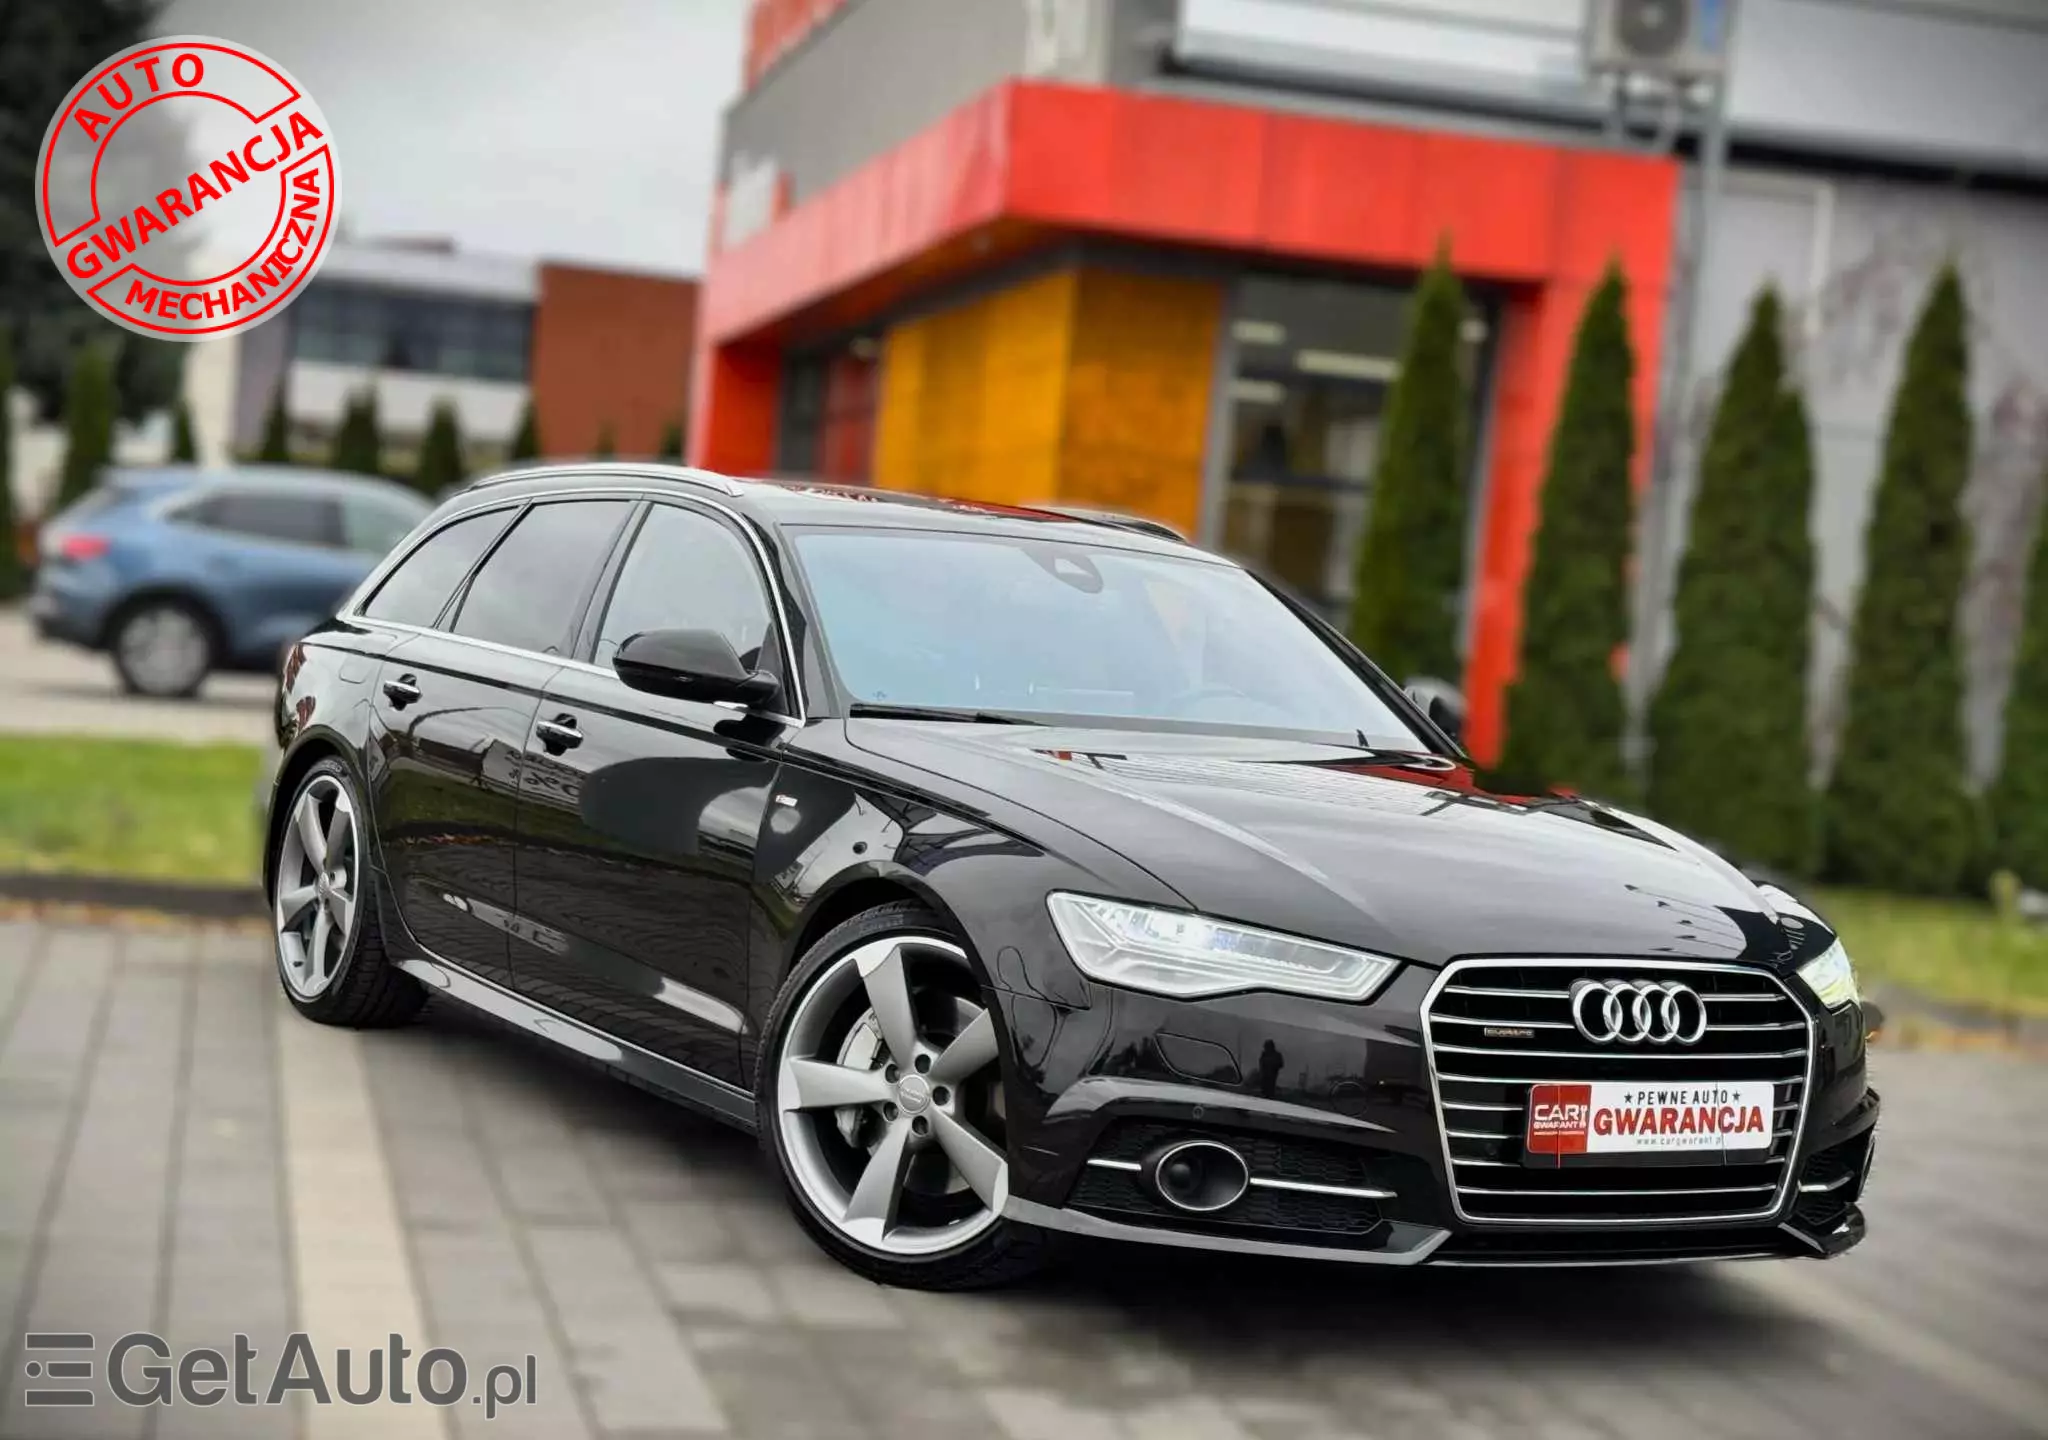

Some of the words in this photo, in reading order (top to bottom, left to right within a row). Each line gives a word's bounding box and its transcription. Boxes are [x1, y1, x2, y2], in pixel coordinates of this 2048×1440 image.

[1637, 1090, 1687, 1106] PEWNE
[1692, 1089, 1728, 1104] AUTO
[1593, 1105, 1765, 1136] GWARANCJA
